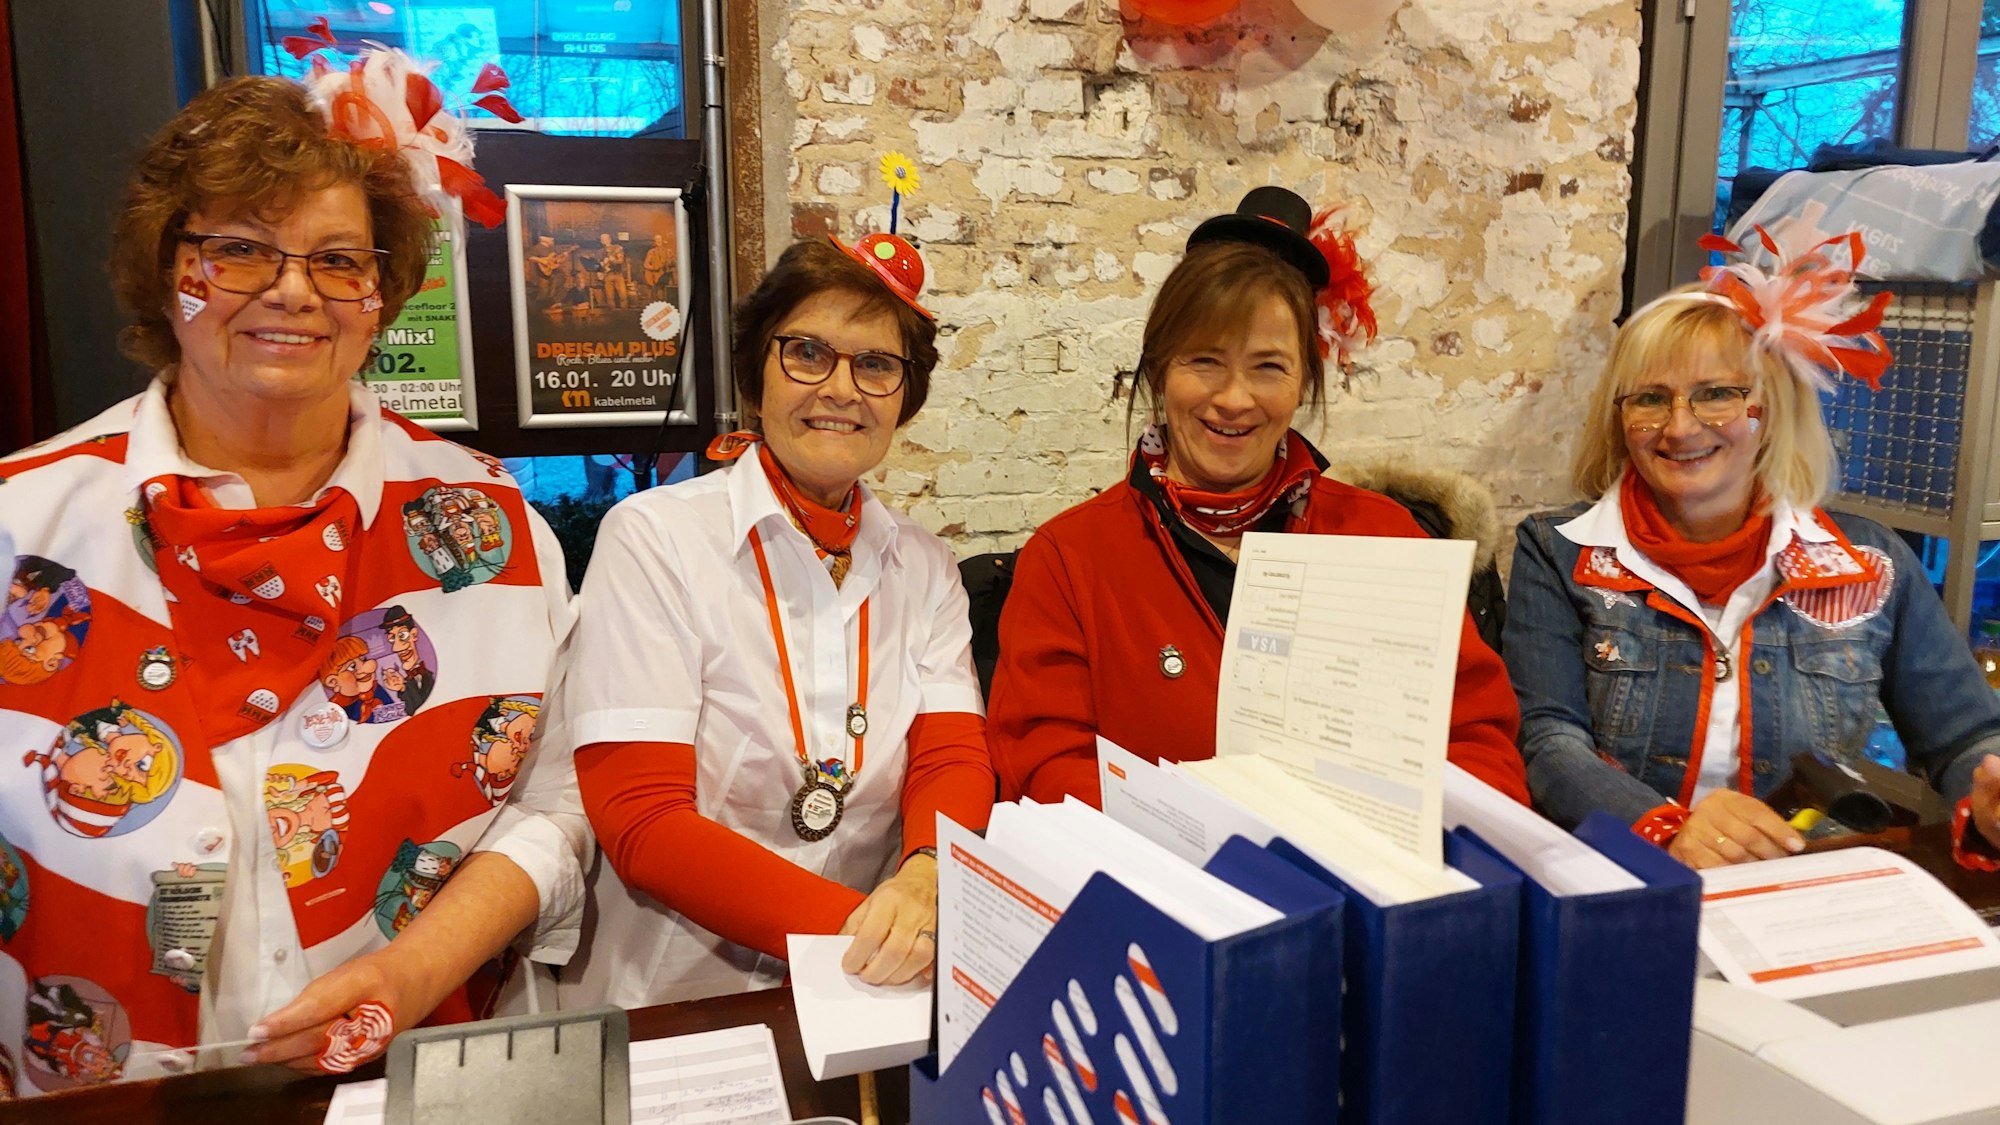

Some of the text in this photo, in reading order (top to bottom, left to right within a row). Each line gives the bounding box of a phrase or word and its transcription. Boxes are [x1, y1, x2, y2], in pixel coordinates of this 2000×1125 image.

[386, 328, 436, 345] Mix!
[536, 340, 678, 358] DREISAM PLUS
[613, 353, 631, 364] und
[400, 382, 435, 393] 02:00
[535, 371, 599, 389] 16.01.
[611, 370, 636, 387] 20
[378, 393, 463, 411] belmetal
[594, 395, 656, 407] kabelmetal
[1250, 634, 1278, 654] VSA
